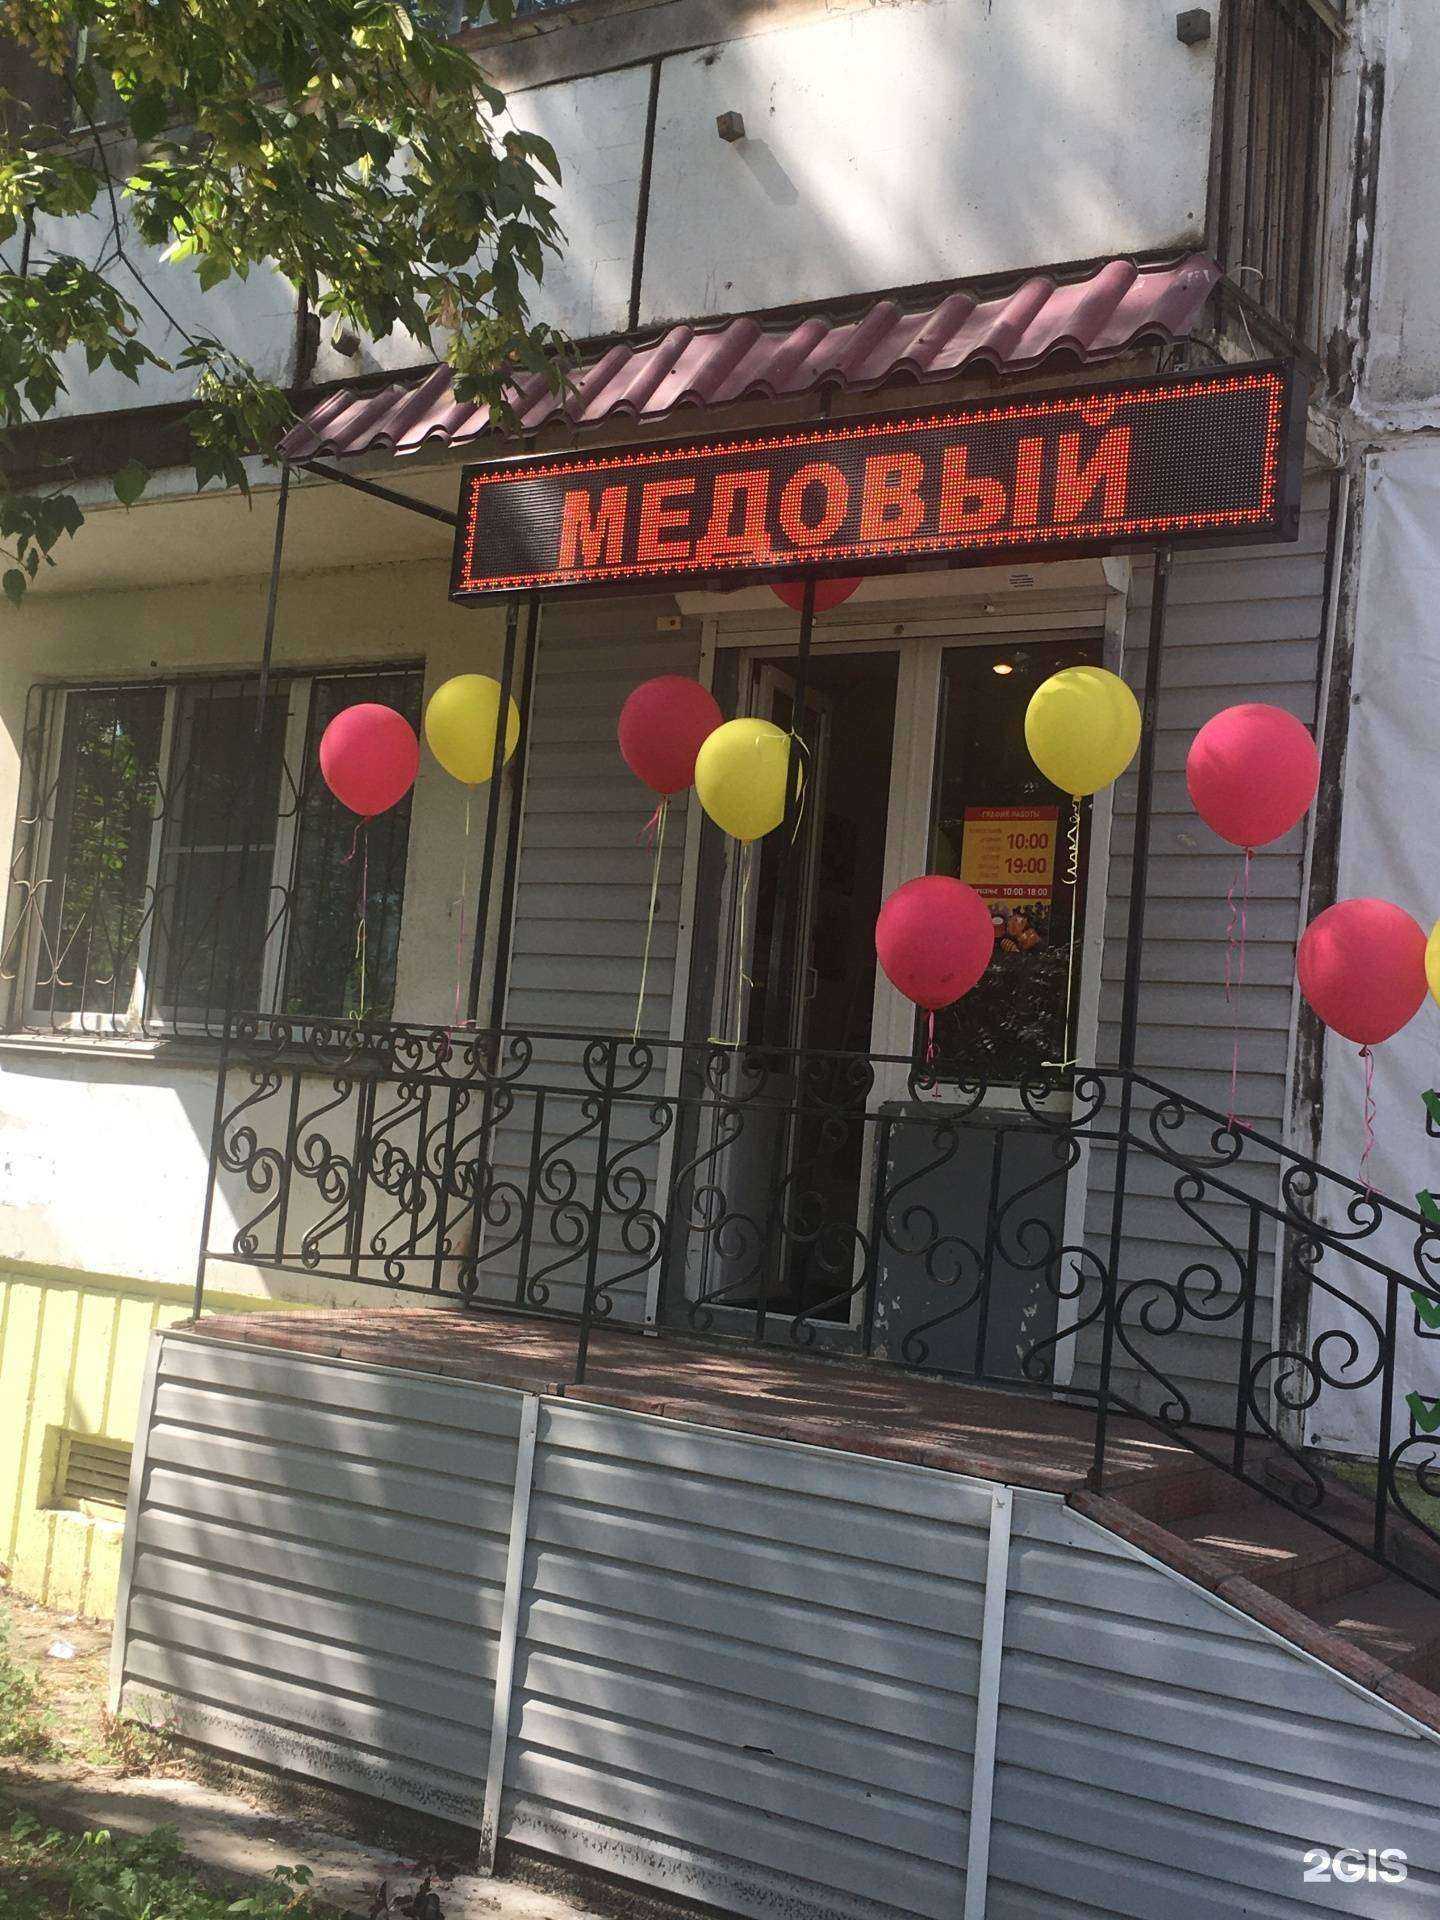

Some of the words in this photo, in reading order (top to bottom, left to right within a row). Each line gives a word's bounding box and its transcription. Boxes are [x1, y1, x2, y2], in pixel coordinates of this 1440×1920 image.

[557, 395, 1131, 570] МЕДОВЫЙ
[1007, 833, 1049, 849] 10:00
[1004, 857, 1047, 873] 19:00
